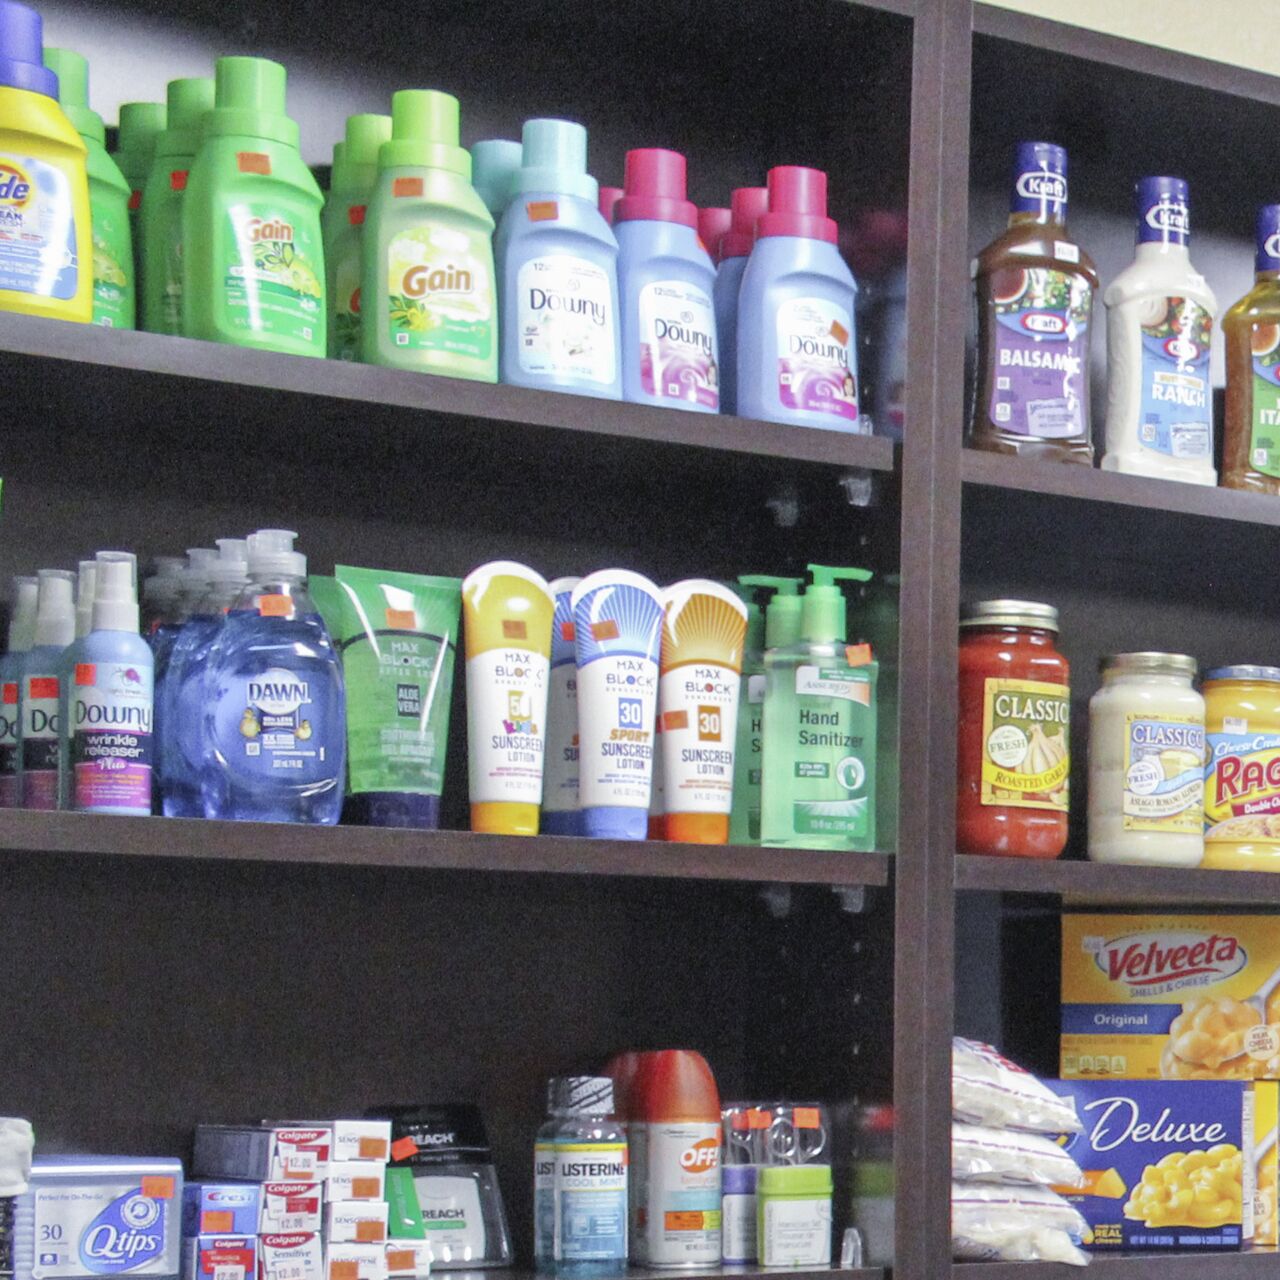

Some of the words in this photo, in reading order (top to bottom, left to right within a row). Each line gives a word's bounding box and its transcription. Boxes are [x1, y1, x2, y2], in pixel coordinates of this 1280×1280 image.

[403, 264, 471, 298] Gain
[530, 289, 606, 326] Downy
[655, 318, 713, 356] Downy
[789, 334, 848, 368] Downy
[1152, 384, 1206, 408] RANCH
[391, 641, 419, 653] MAX
[504, 653, 531, 665] MAX
[616, 659, 644, 671] MAX
[606, 673, 653, 687] BLOCK
[695, 669, 721, 680] MAX
[248, 682, 309, 703] DAWN
[685, 681, 732, 695] BLOCK
[398, 689, 420, 702] ALOE
[76, 700, 150, 732] Downy
[398, 702, 421, 716] VERA
[619, 702, 641, 725] 30
[699, 711, 720, 733] 30
[800, 709, 839, 727] Hand
[87, 735, 138, 748] wrinkle
[609, 728, 649, 742] SPORT
[799, 730, 865, 751] Sanitizer
[84, 744, 141, 758] releaser
[989, 739, 1027, 753] FRESH
[507, 751, 536, 764] LOTION
[616, 758, 646, 771] LOTION
[697, 763, 725, 776] LOTION
[994, 770, 1043, 790] ROASTED
[1244, 801, 1271, 815] Double
[1106, 933, 1239, 981] Velveeta
[1094, 1012, 1148, 1027] Original
[1083, 1097, 1226, 1152] Deluxe
[277, 1130, 318, 1143] Colgate
[268, 1183, 307, 1195] Colgate
[422, 1208, 465, 1221] REACH
[40, 1224, 62, 1241] 30
[215, 1240, 244, 1249] Colgate
[265, 1234, 306, 1247] Colgate
